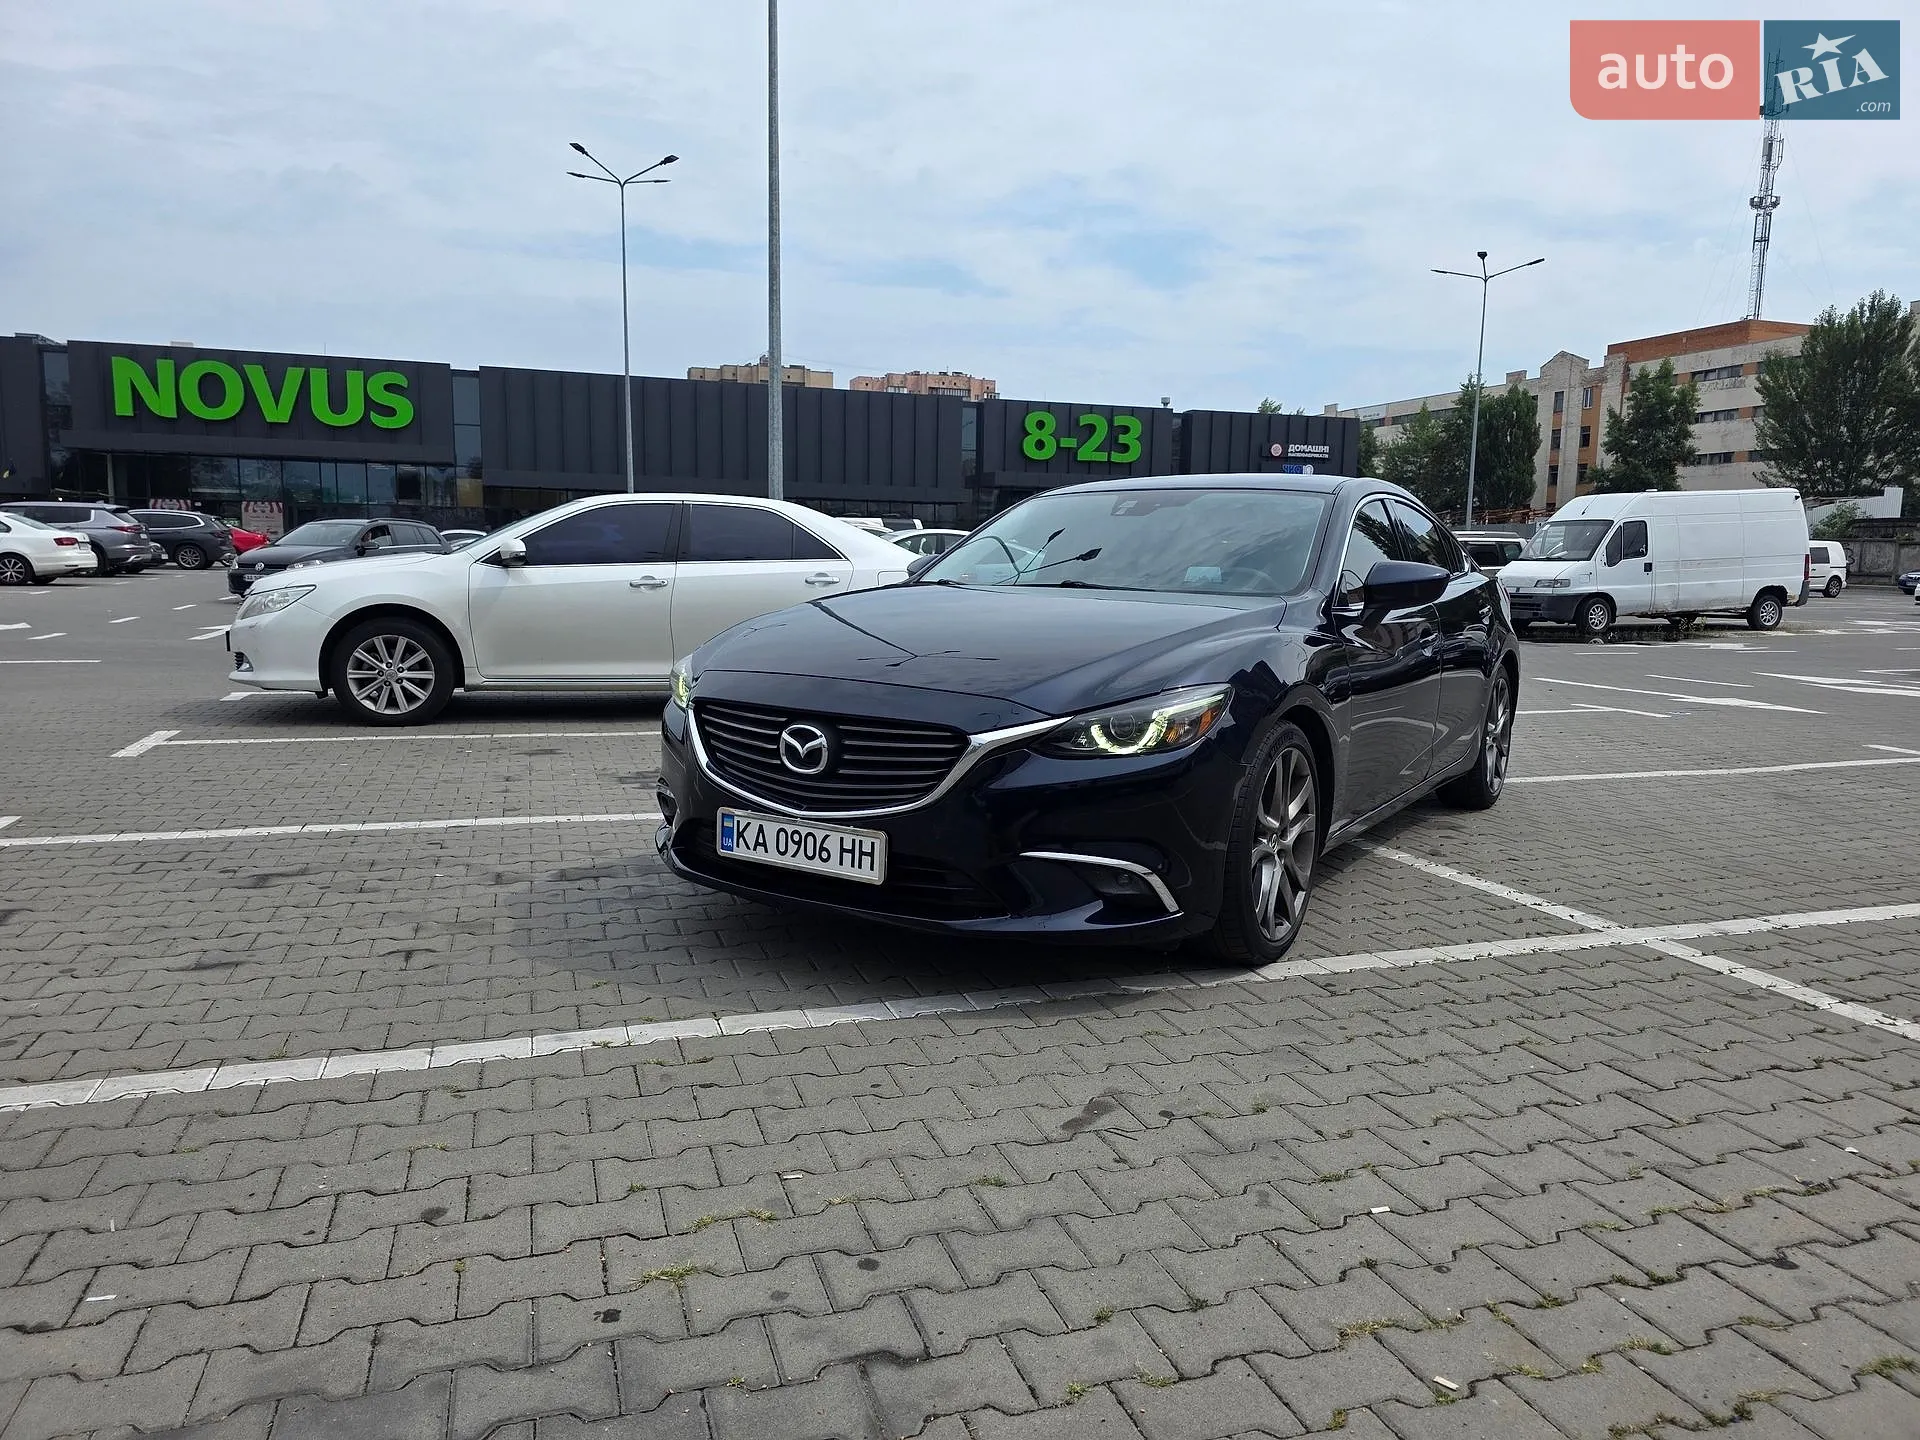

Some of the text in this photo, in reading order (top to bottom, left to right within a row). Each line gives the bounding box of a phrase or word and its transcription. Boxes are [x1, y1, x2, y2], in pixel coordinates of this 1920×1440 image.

[112, 356, 414, 429] NOVUS
[1022, 411, 1142, 463] 8-23
[1288, 444, 1330, 453] ДОМАШНІ
[723, 837, 733, 847] UA
[736, 819, 876, 872] KA 0906 HH
